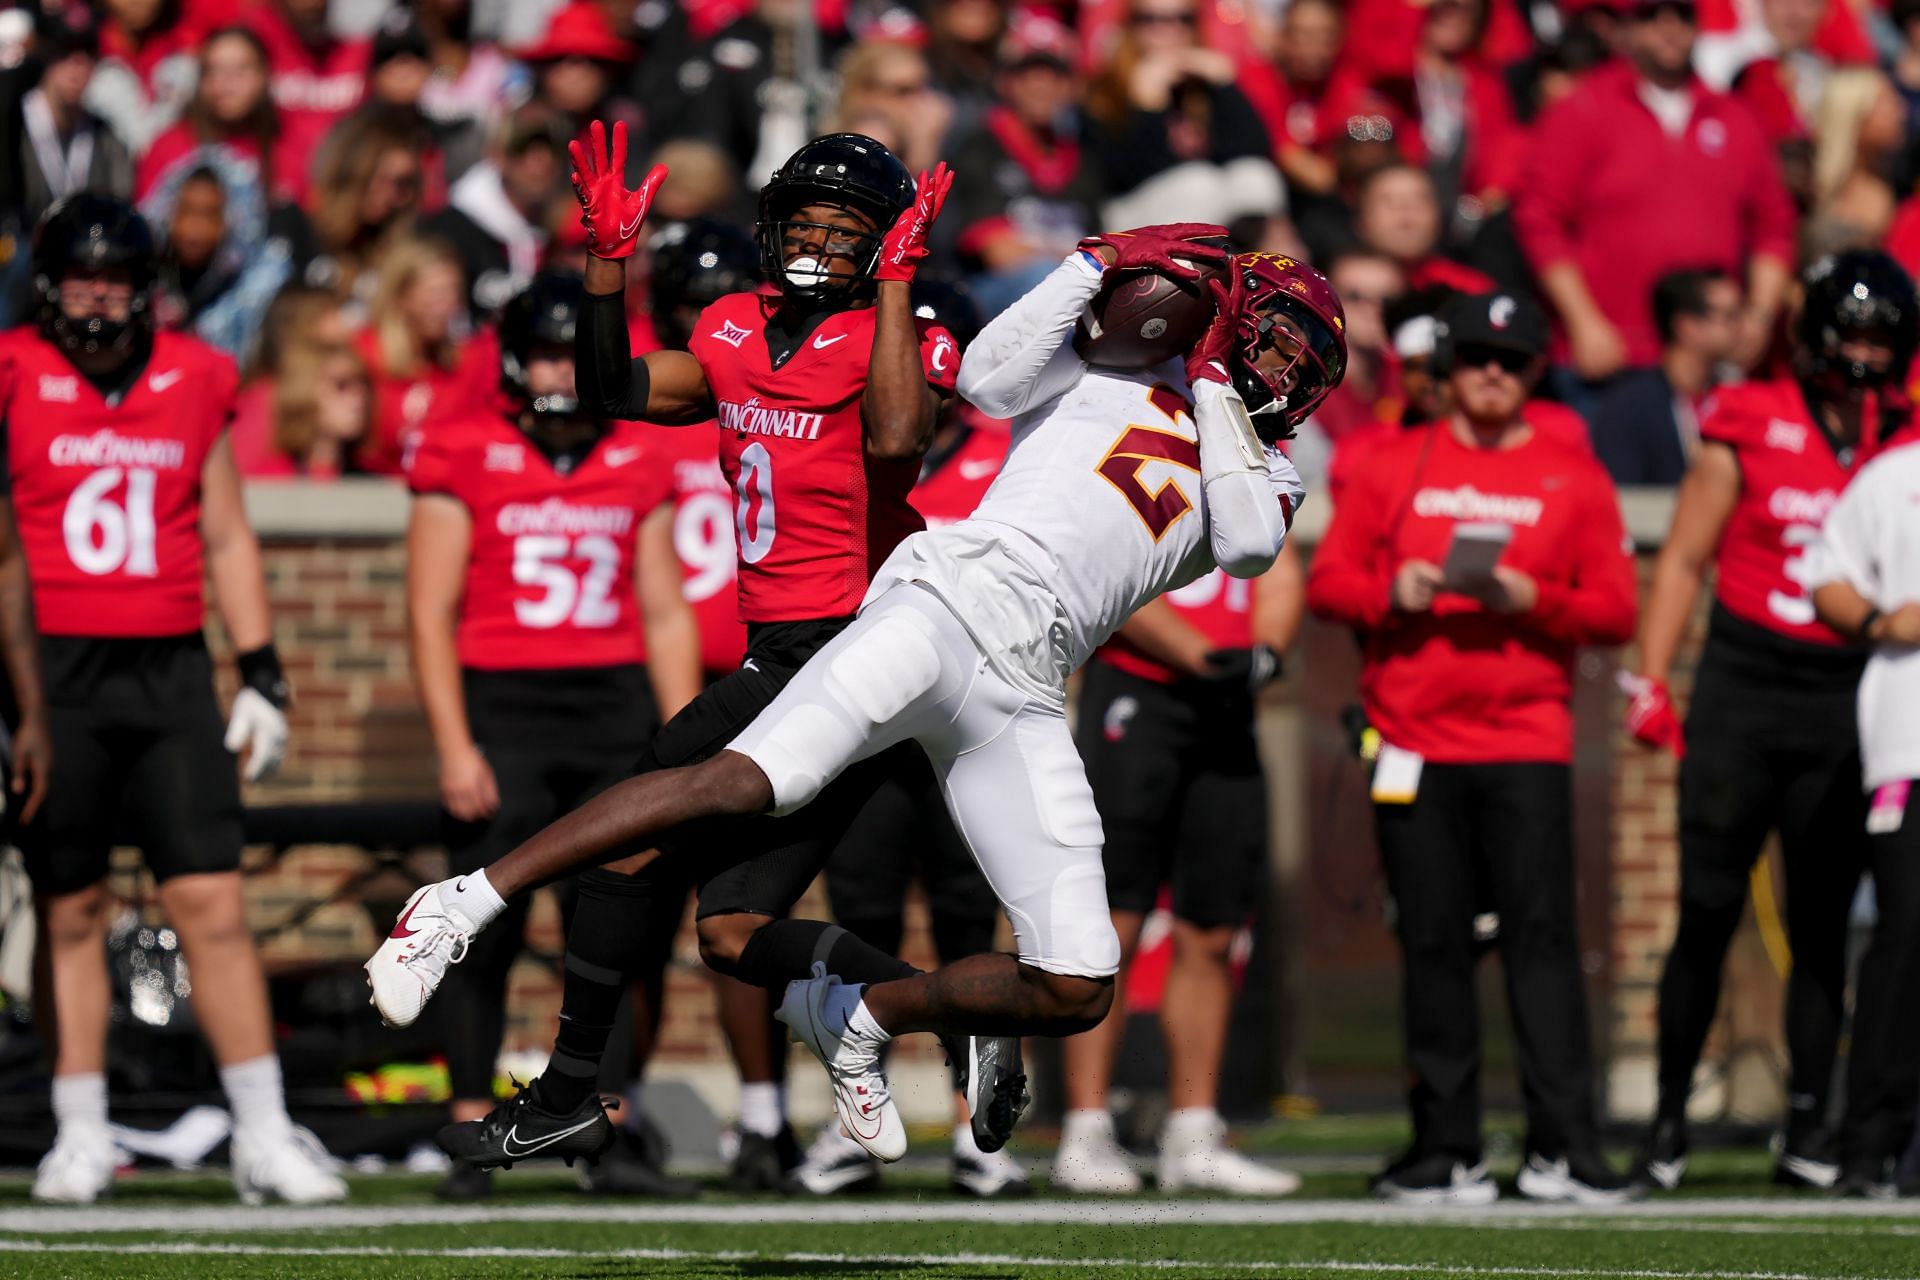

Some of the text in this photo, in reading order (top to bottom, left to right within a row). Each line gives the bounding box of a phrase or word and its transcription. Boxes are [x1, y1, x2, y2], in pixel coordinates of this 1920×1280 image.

[718, 398, 824, 440] CINCINNATI
[1094, 381, 1201, 545] 2
[62, 465, 158, 577] 61
[737, 442, 776, 564] 0
[512, 535, 621, 629] 52
